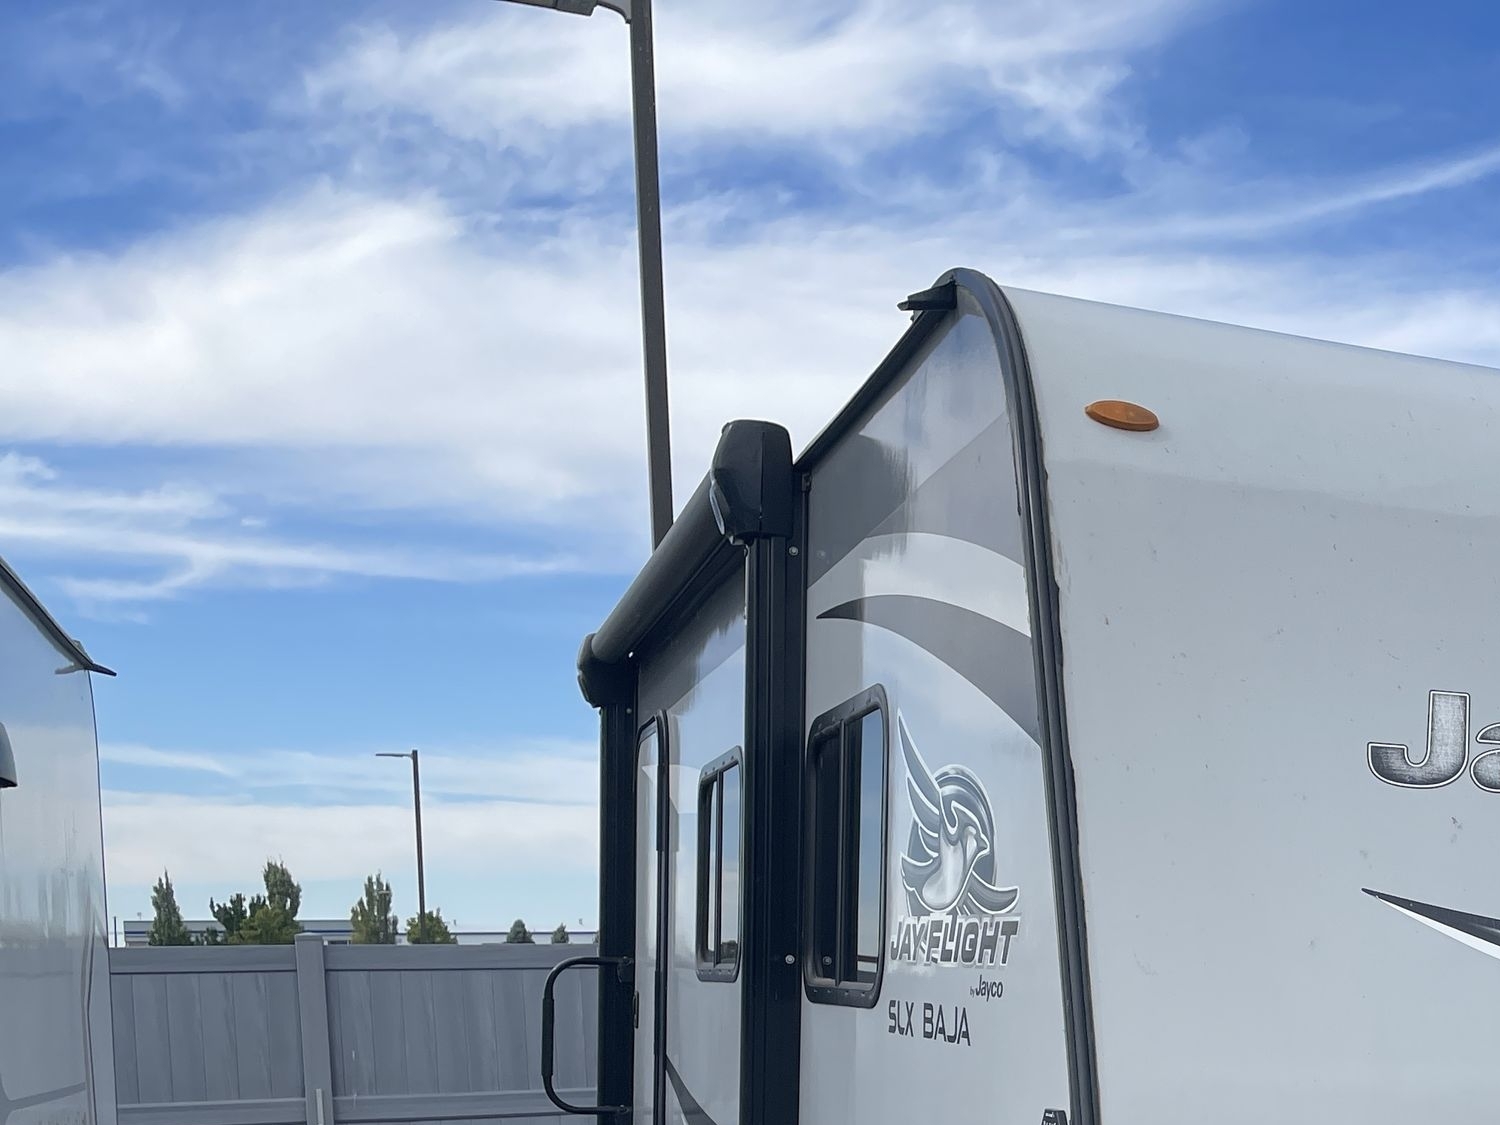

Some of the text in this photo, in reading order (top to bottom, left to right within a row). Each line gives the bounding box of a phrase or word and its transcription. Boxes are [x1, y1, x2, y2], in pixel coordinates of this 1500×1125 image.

[889, 916, 1020, 966] JAY FLIGHT
[975, 974, 1003, 1002] Jayco
[888, 999, 971, 1047] SLX BAJA
